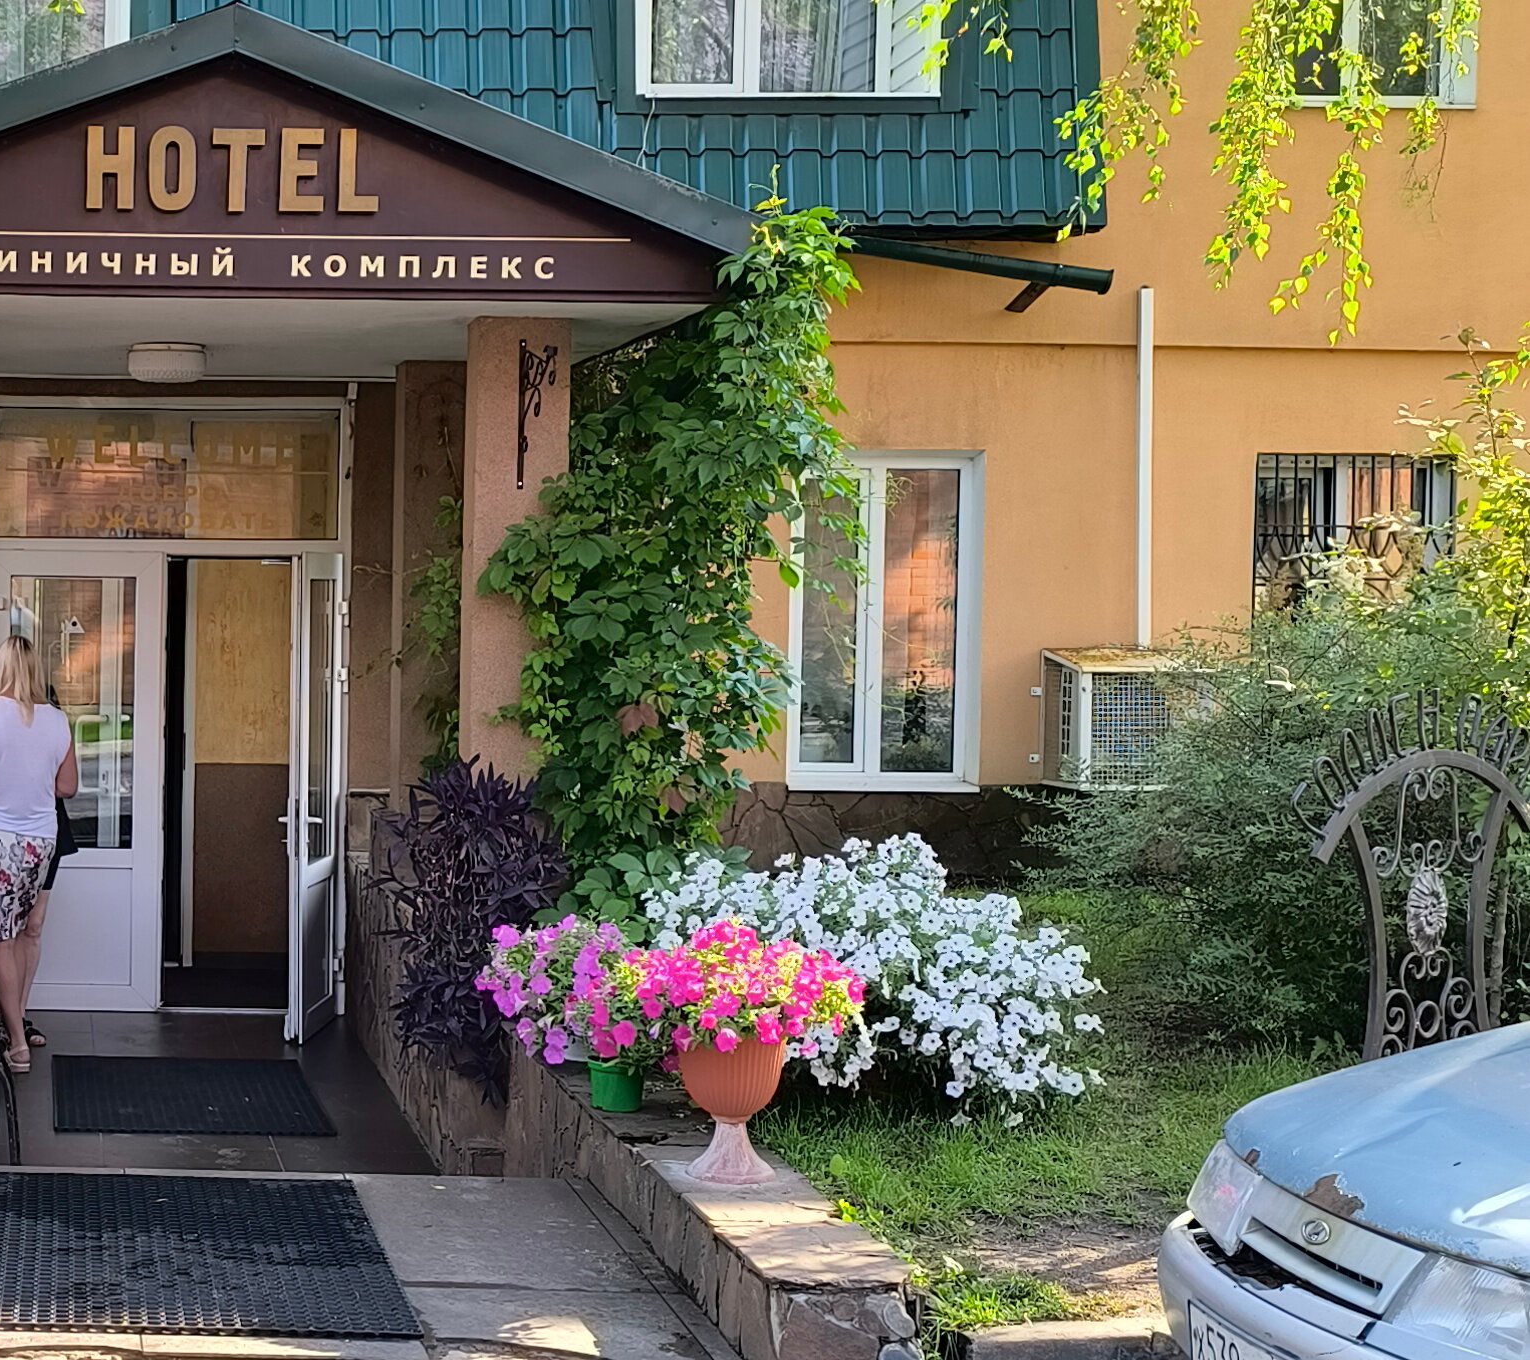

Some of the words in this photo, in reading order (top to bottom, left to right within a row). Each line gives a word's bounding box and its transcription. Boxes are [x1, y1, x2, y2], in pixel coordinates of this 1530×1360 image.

[86, 125, 380, 213] HOTEL
[290, 254, 555, 280] КОМПЛЕКС
[46, 423, 298, 467] WELCOME
[119, 484, 226, 503] ДОБРО
[60, 512, 276, 531] ПОЖАЛОВАТЬ
